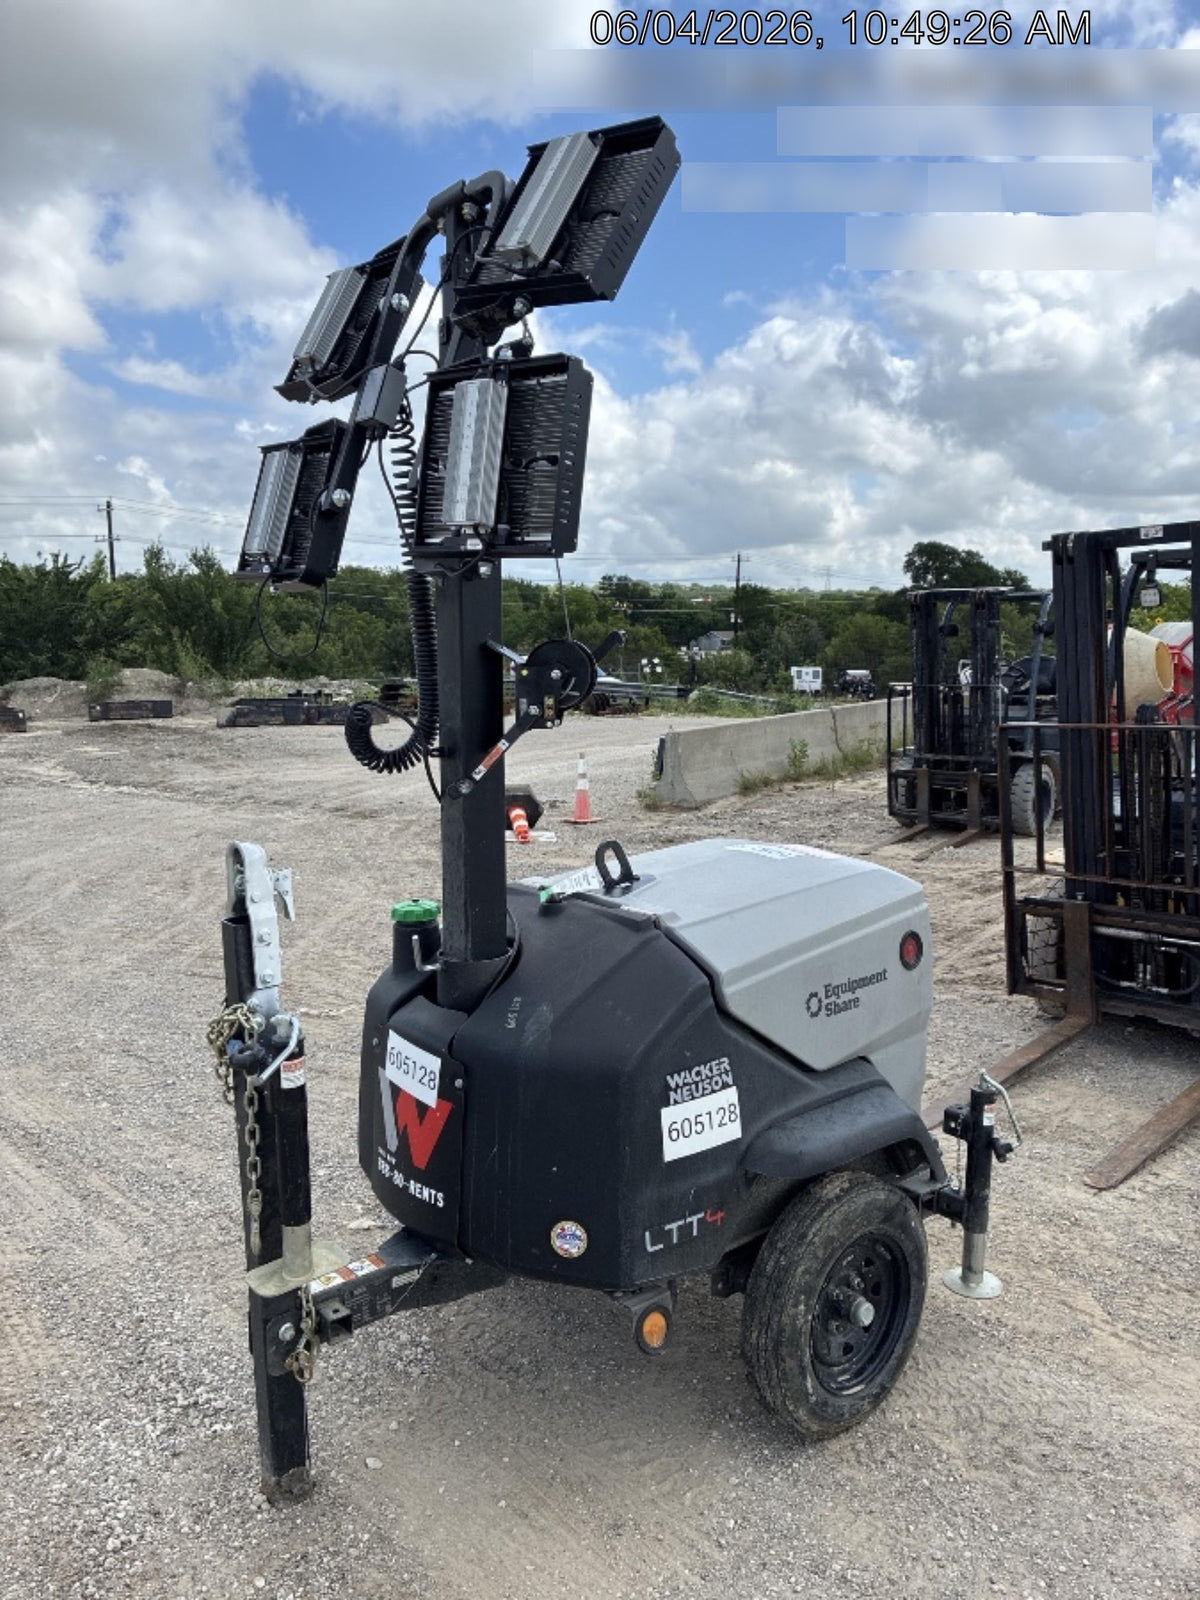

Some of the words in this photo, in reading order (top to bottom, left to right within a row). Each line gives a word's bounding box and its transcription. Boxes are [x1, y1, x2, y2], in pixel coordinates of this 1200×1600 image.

[823, 967, 888, 999] Equipment
[824, 997, 861, 1017] Share
[388, 1046, 437, 1091] 605128
[666, 1057, 732, 1089] WACKER
[669, 1071, 734, 1105] NEUSON
[668, 1103, 739, 1142] 605128
